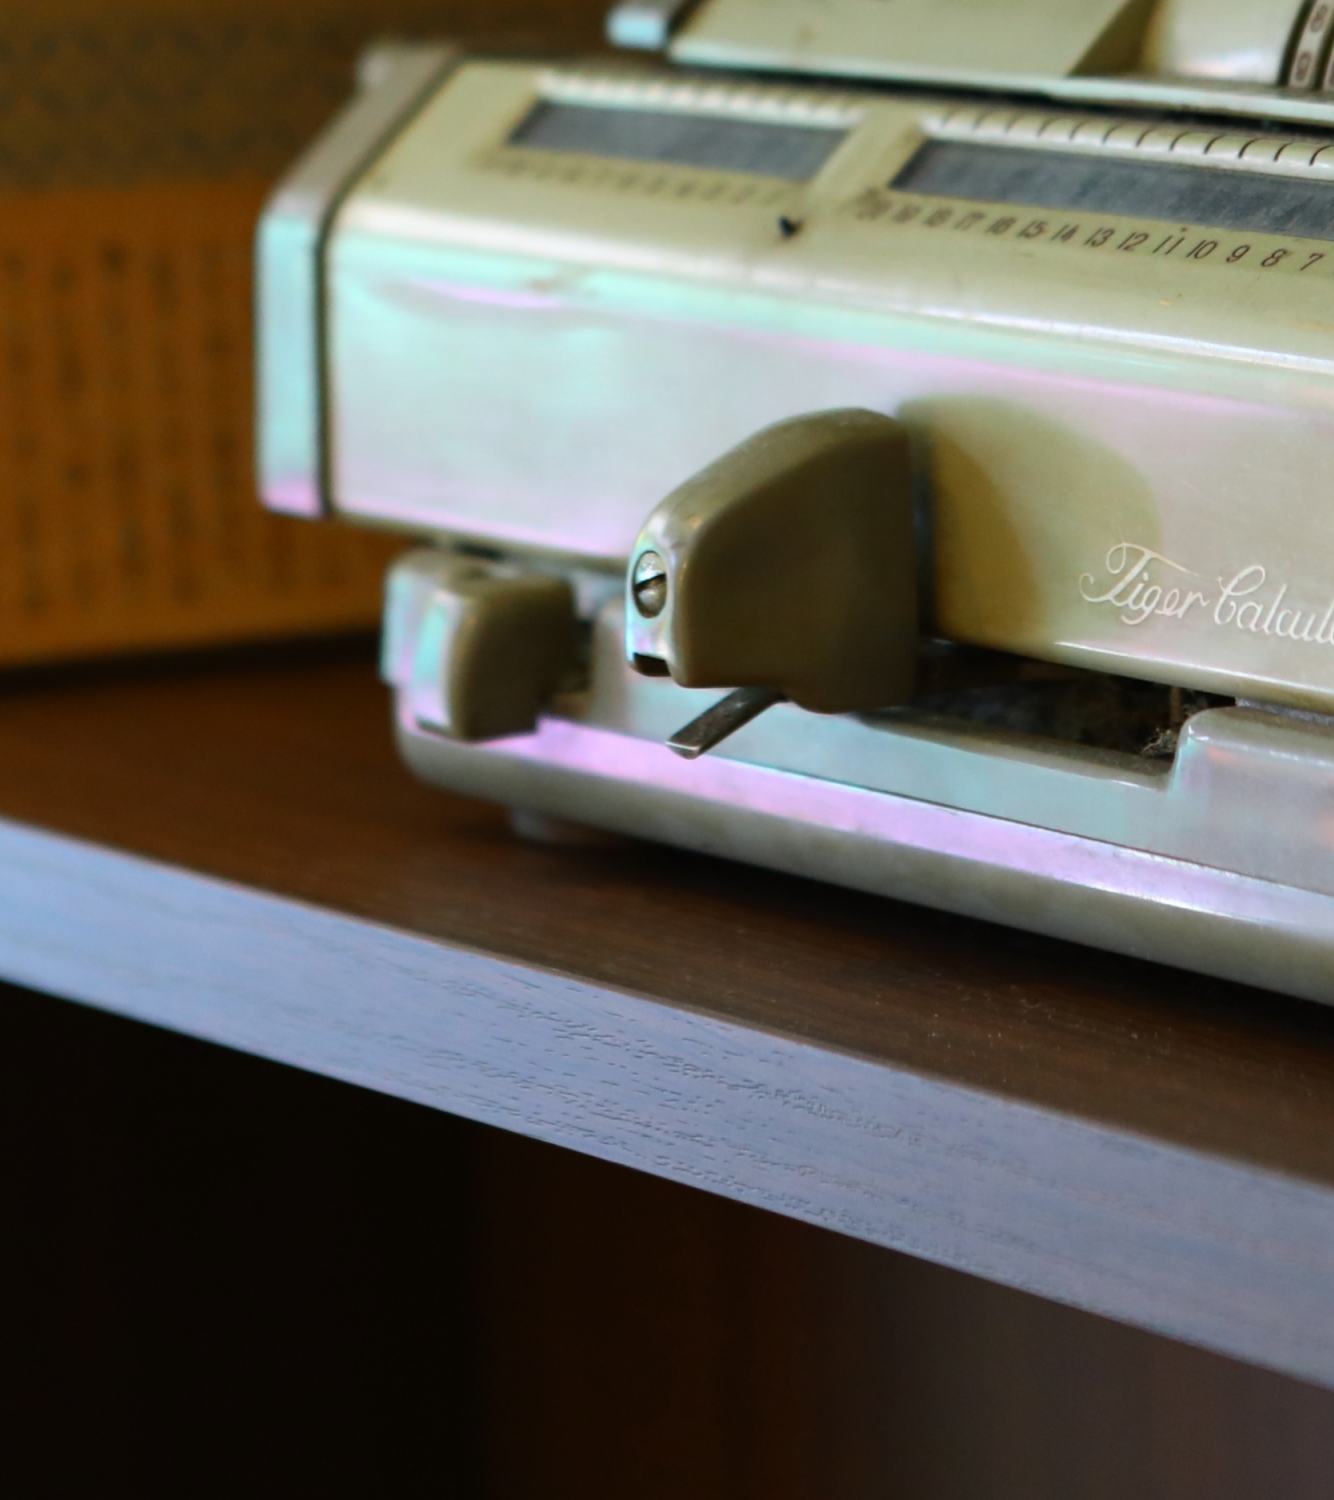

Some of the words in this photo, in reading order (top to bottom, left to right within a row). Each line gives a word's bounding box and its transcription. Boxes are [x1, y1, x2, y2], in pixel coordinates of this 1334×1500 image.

[1017, 220, 1049, 239] 15
[1051, 224, 1080, 242] 14
[1084, 228, 1115, 247] 13
[1117, 232, 1149, 251] 12
[1153, 235, 1186, 255] 11
[1186, 239, 1219, 259] 10
[1226, 244, 1251, 263] 9
[1261, 248, 1288, 267] 8
[1300, 252, 1325, 271] 7
[1079, 543, 1214, 627] Tiger
